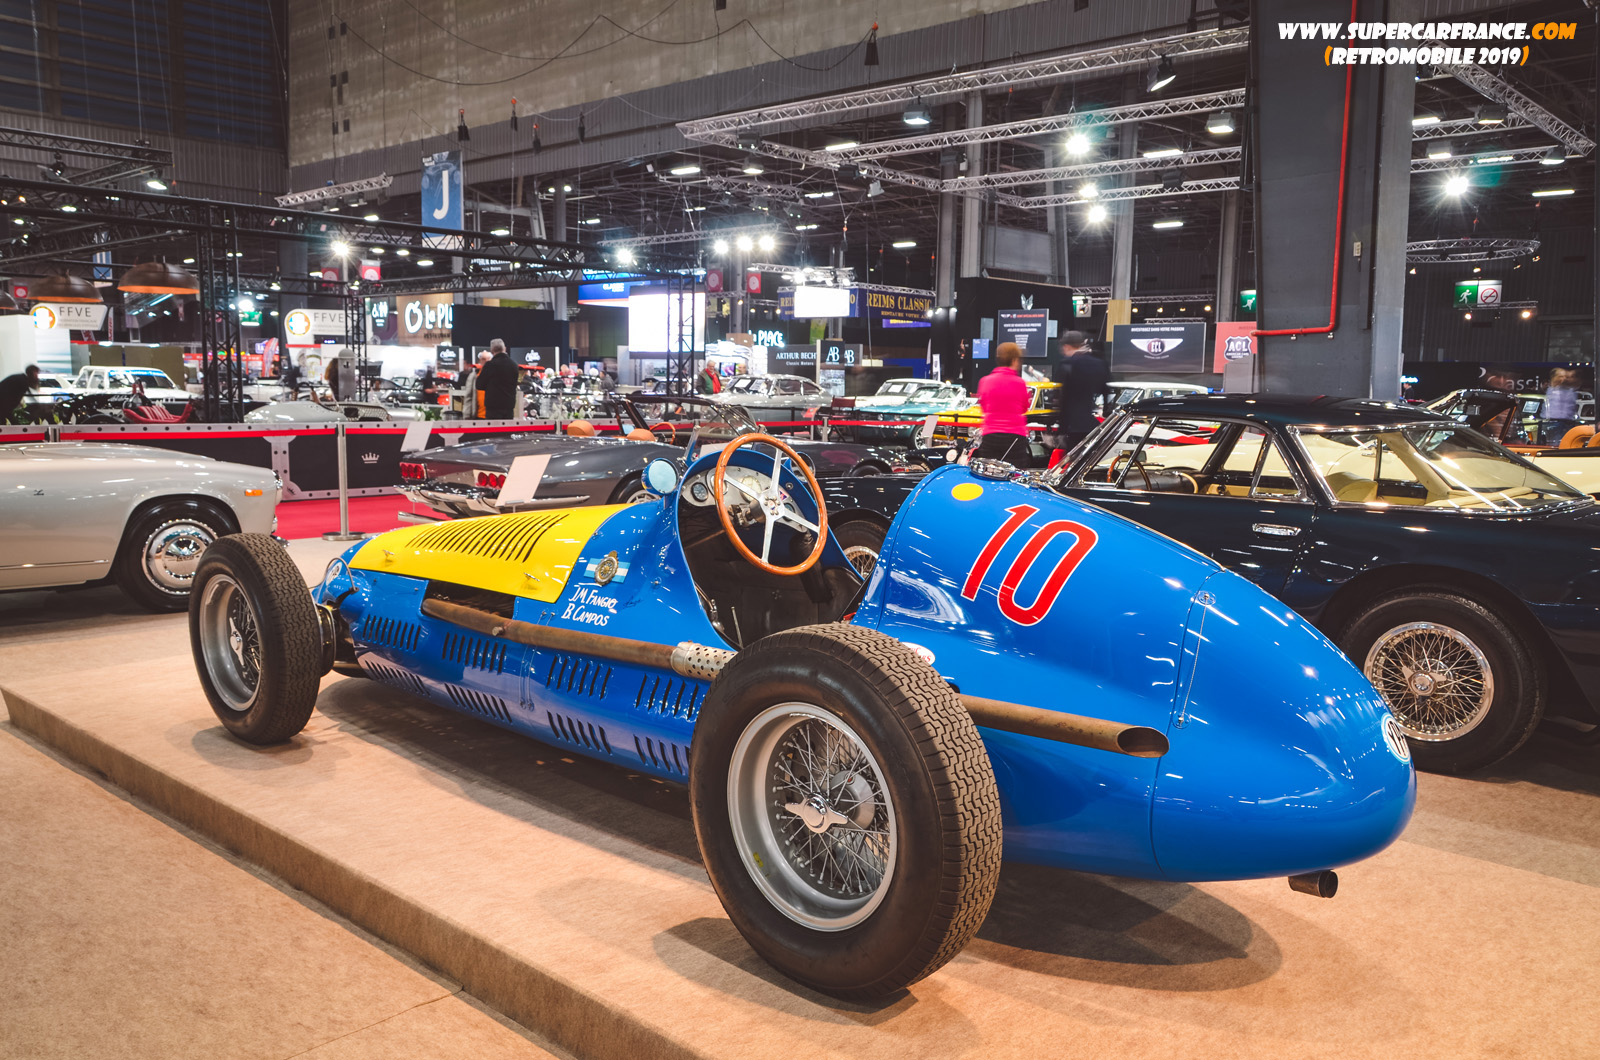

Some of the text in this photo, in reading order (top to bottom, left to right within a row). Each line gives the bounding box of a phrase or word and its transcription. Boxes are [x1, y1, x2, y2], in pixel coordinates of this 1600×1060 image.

[433, 170, 449, 220] J
[867, 293, 895, 309] REIMS
[59, 306, 91, 317] FFVE
[314, 312, 345, 323] FFVE
[1228, 341, 1248, 352] ACL
[776, 352, 816, 360] ARTHUR BECH
[826, 346, 840, 362] AB
[960, 503, 1099, 627] 10
